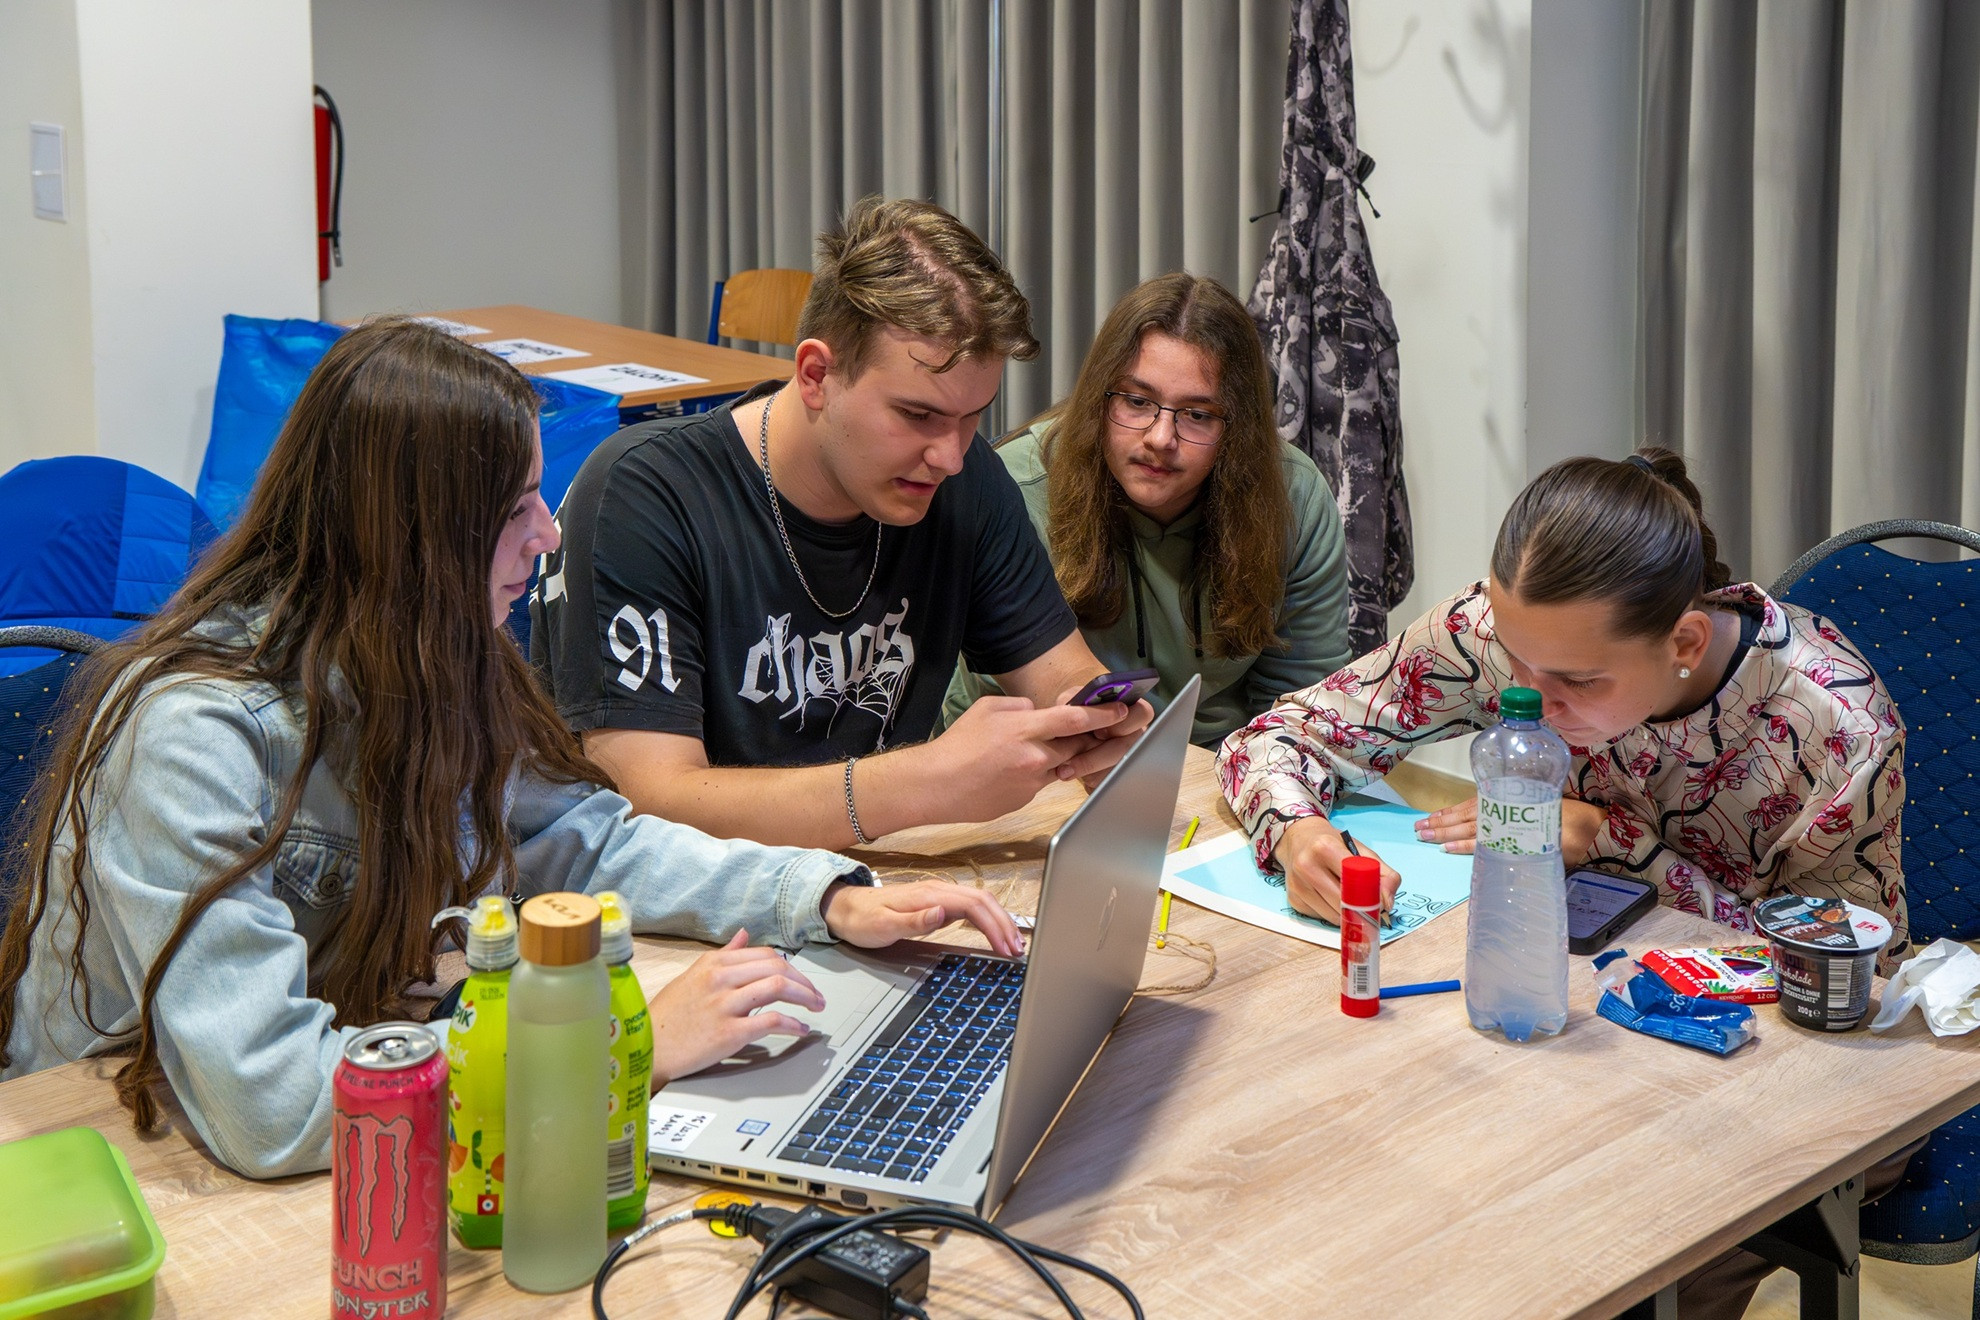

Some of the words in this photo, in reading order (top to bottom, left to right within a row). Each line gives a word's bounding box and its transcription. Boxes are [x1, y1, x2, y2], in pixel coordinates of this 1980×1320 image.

[608, 604, 681, 693] 91
[737, 597, 914, 720] chaos
[1481, 798, 1536, 825] RAJEC
[333, 1287, 430, 1320] ONSTER
